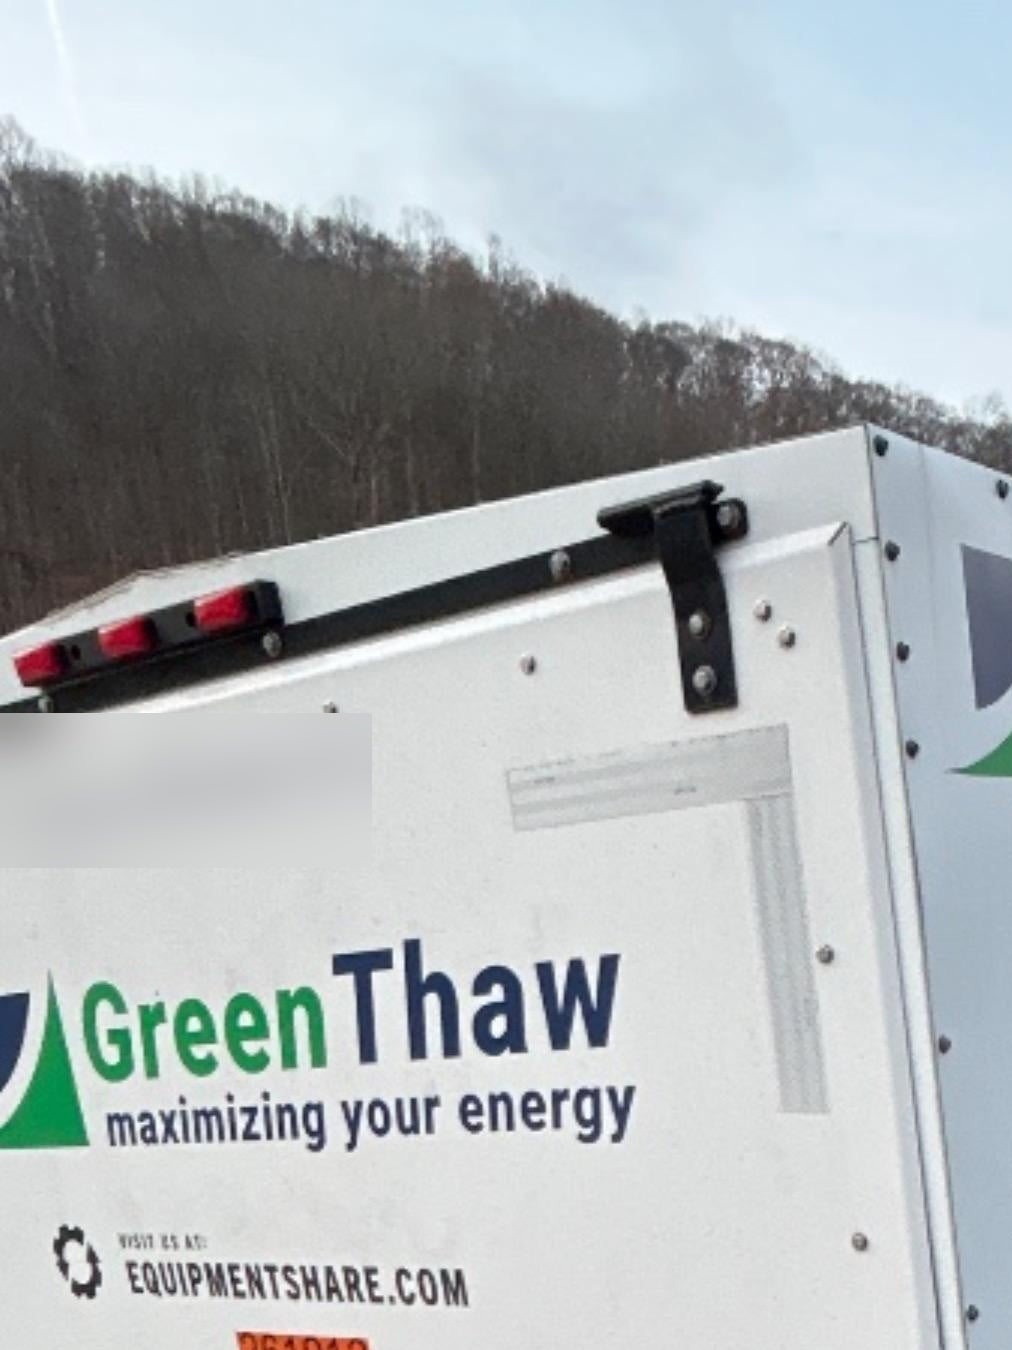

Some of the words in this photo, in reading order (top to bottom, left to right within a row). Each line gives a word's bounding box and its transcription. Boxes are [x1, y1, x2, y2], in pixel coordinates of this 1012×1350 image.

[106, 1091, 326, 1152] maximizing
[341, 1094, 441, 1152] your
[458, 1085, 636, 1143] energy
[118, 1233, 154, 1250] VISIT
[126, 1259, 470, 1308] EQUIPMENTSHARE.COM
